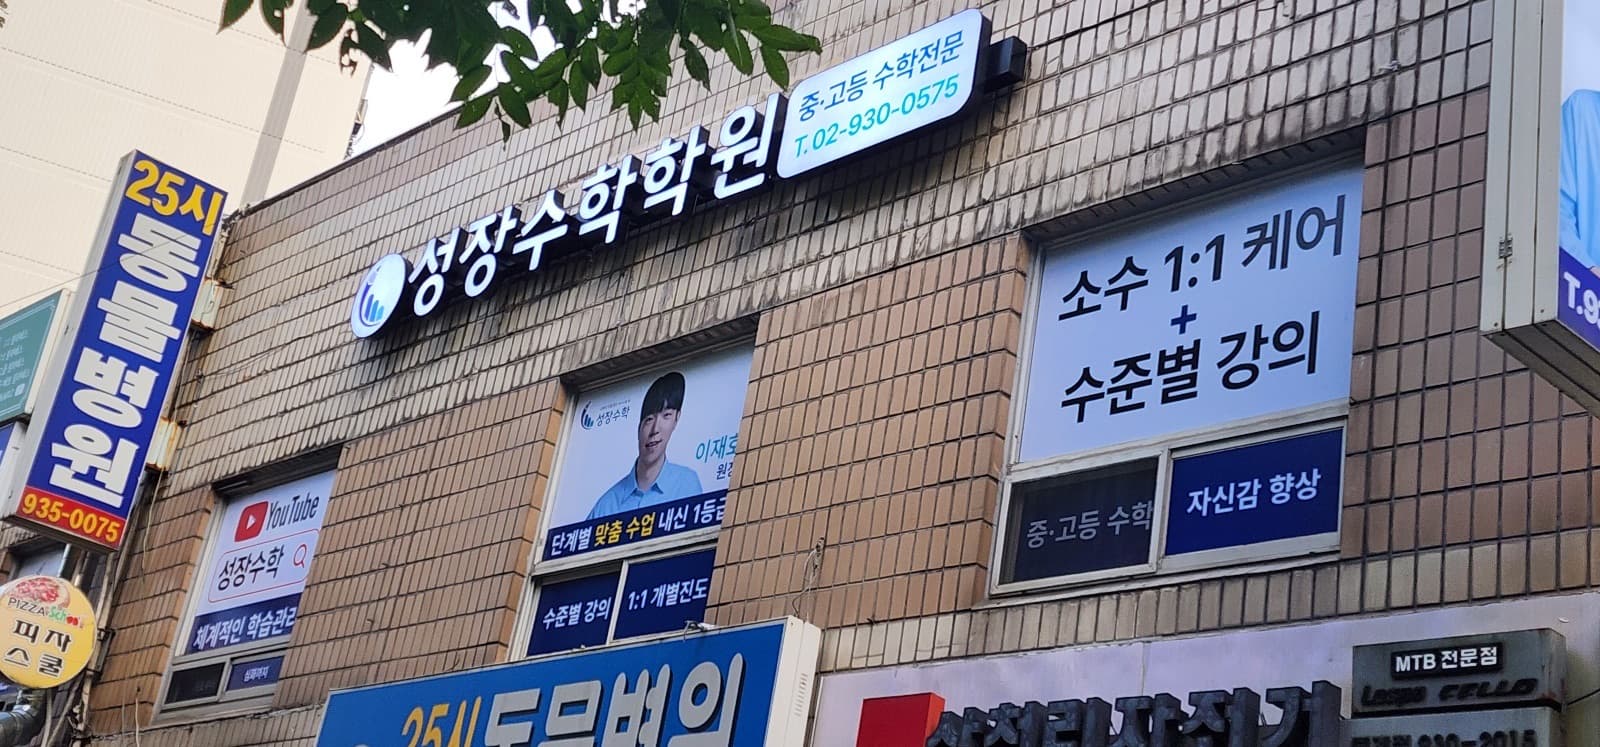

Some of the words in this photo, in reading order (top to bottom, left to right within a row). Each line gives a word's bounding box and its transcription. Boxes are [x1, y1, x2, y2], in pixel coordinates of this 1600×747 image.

[872, 30, 964, 90] 수학전문
[124, 159, 224, 236] 25시
[408, 93, 784, 317] 성장수학학원
[1058, 256, 1149, 321] 소수
[1164, 234, 1225, 292] 1:1
[1242, 194, 1346, 270] 케어
[1563, 271, 1600, 331] T.9
[50, 212, 202, 509] 동물병원
[1061, 338, 1201, 424] 수준별
[1216, 310, 1320, 390] 강의
[596, 406, 631, 427] 성장수학
[266, 492, 320, 531] YouTube
[1186, 480, 1261, 517] 자신감
[1269, 467, 1321, 505] 향상
[22, 493, 121, 543] 935-0075
[551, 525, 593, 556] 단계별
[594, 519, 623, 547] 맞춤
[625, 511, 656, 539] 수업
[658, 504, 689, 532] 내신
[1107, 499, 1153, 536] 수학
[218, 544, 285, 591] 성장수학
[8, 597, 46, 617] PIZZA
[542, 602, 582, 630] 수준별
[583, 596, 612, 623] 강의
[628, 589, 648, 611] 1:1
[650, 577, 709, 608] 개별진도
[13, 619, 72, 652] 피자
[193, 616, 246, 650] 체계적인
[4, 647, 64, 678] 스쿨
[1395, 654, 1436, 672] MTB
[1441, 646, 1498, 669] 전문점
